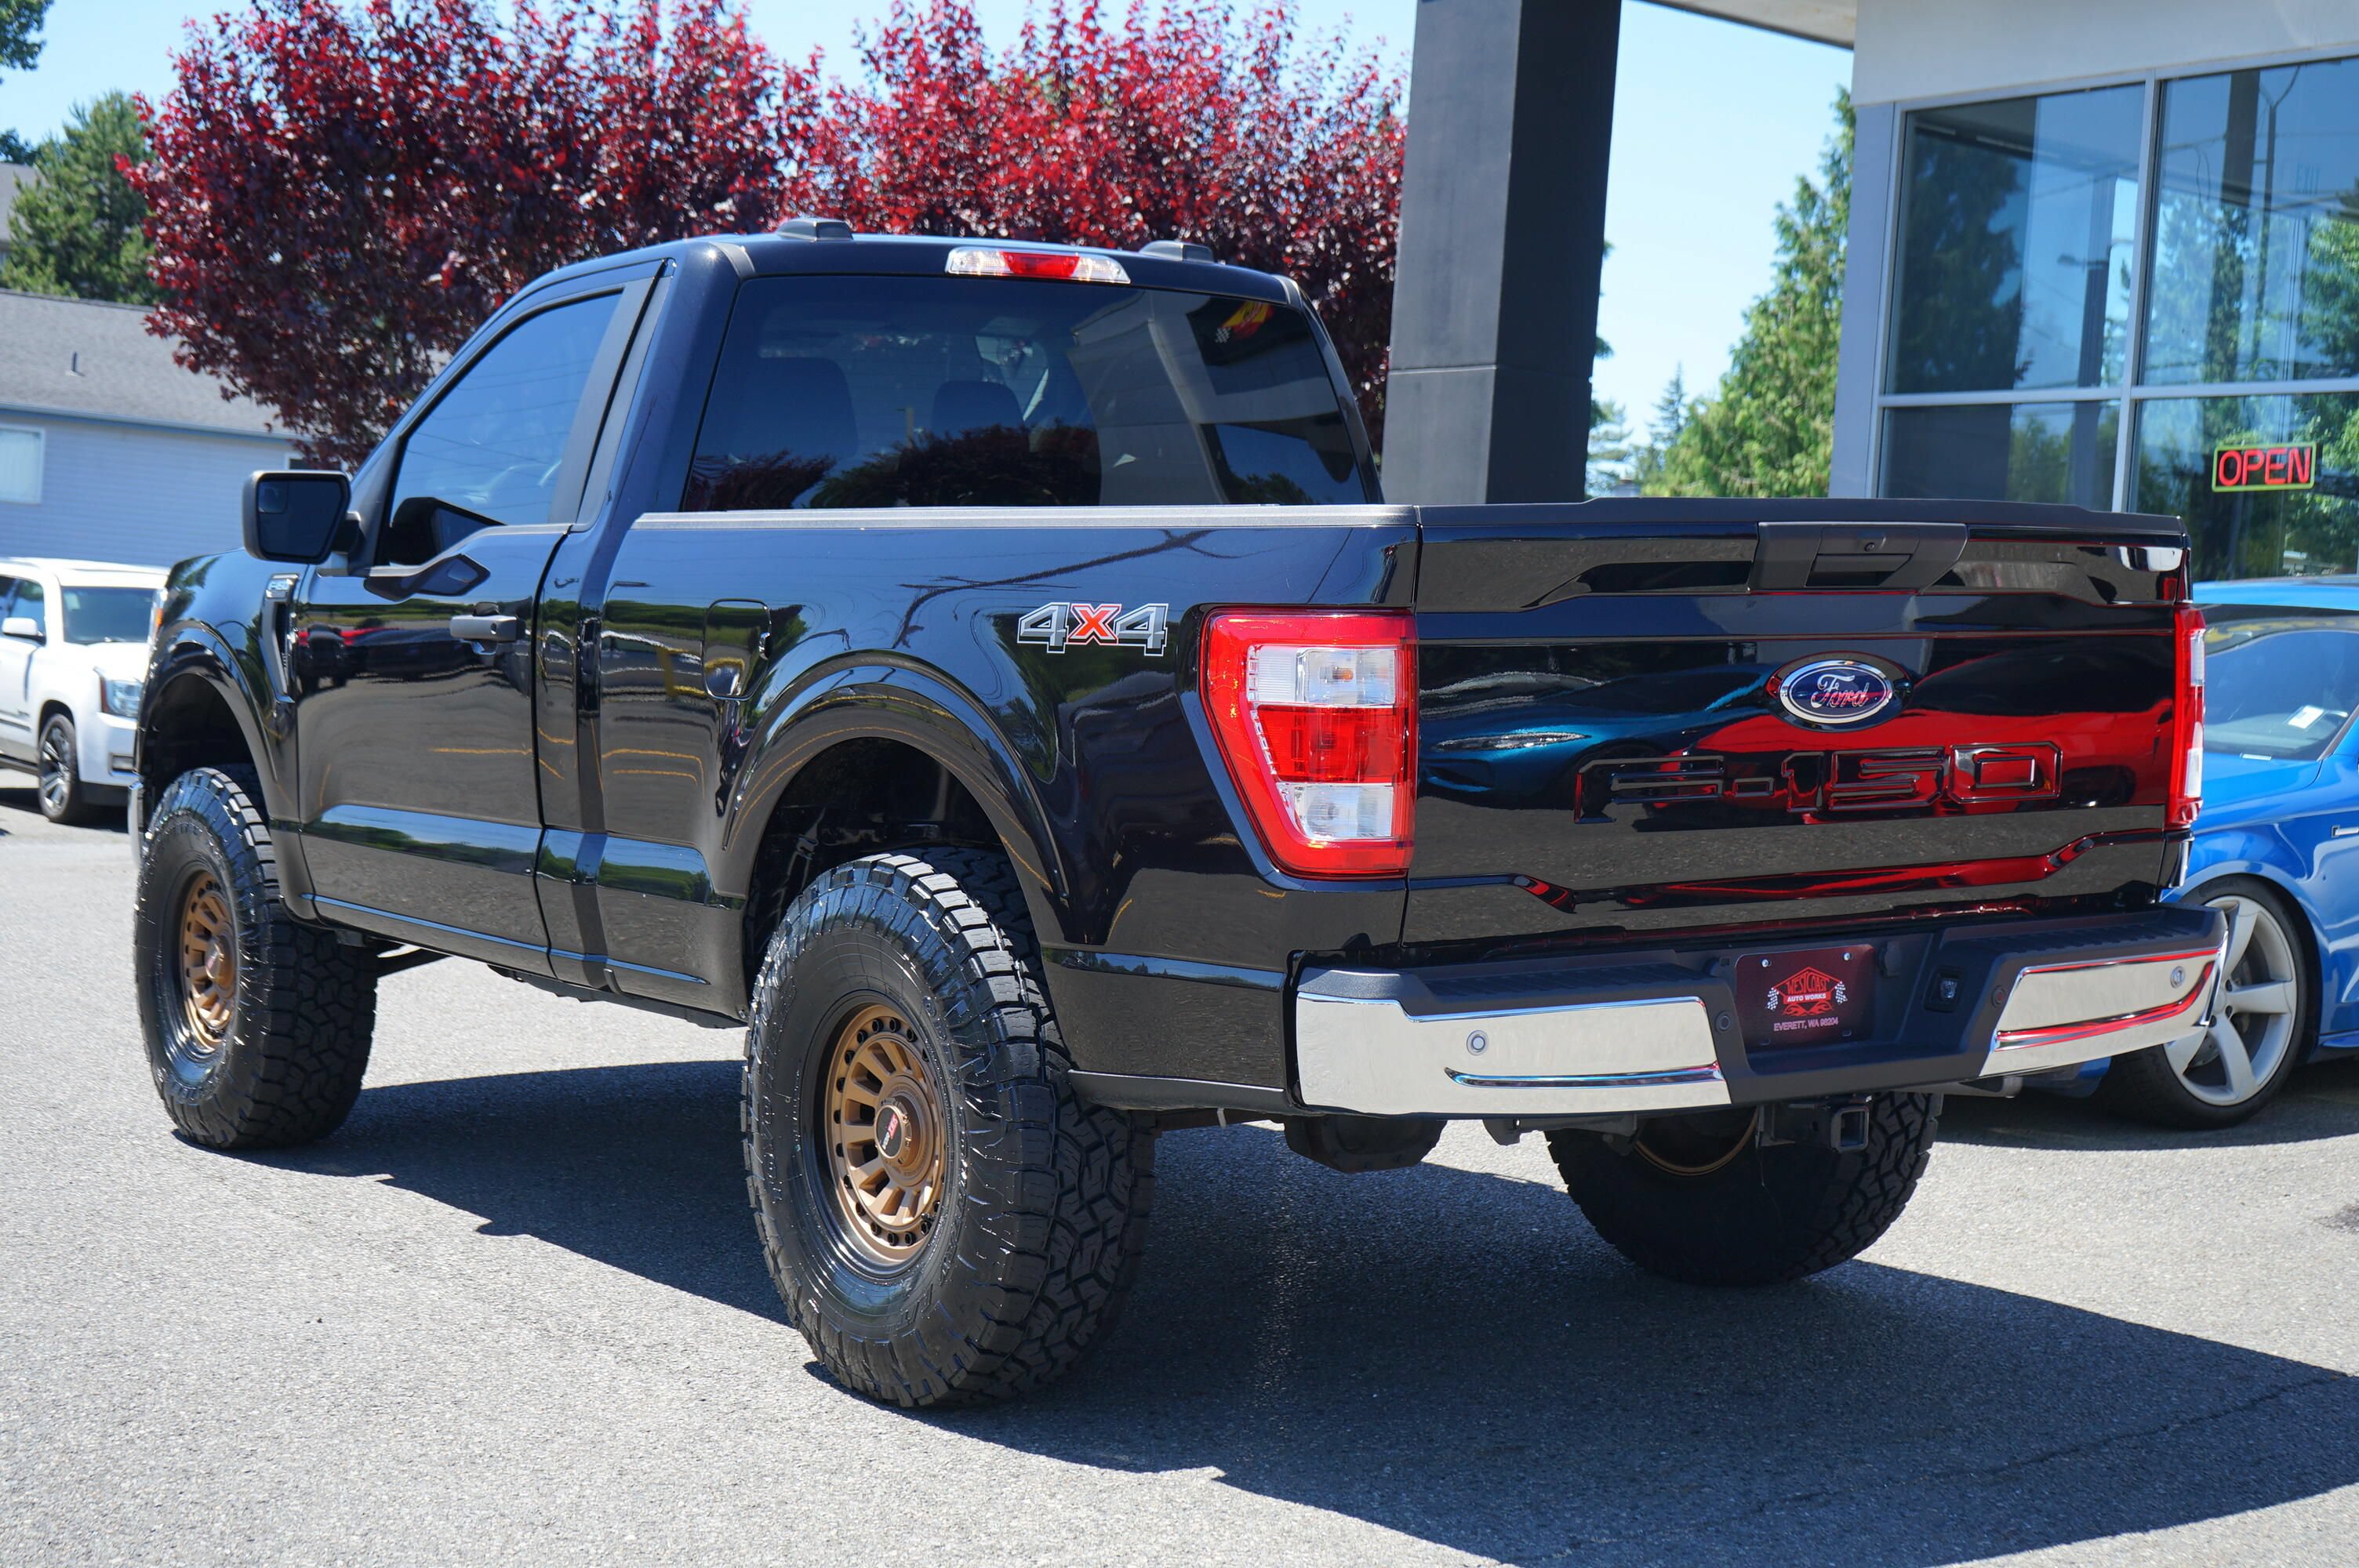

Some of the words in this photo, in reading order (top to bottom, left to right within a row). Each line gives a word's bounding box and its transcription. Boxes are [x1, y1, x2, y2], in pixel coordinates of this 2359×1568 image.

[2219, 447, 2311, 487] OPEN
[1811, 674, 1870, 708] Ford
[1574, 742, 2063, 824] F-150
[1805, 993, 1826, 1001] WORKS
[1773, 1020, 1807, 1032] EVERETT,
[1808, 1018, 1819, 1029] WA
